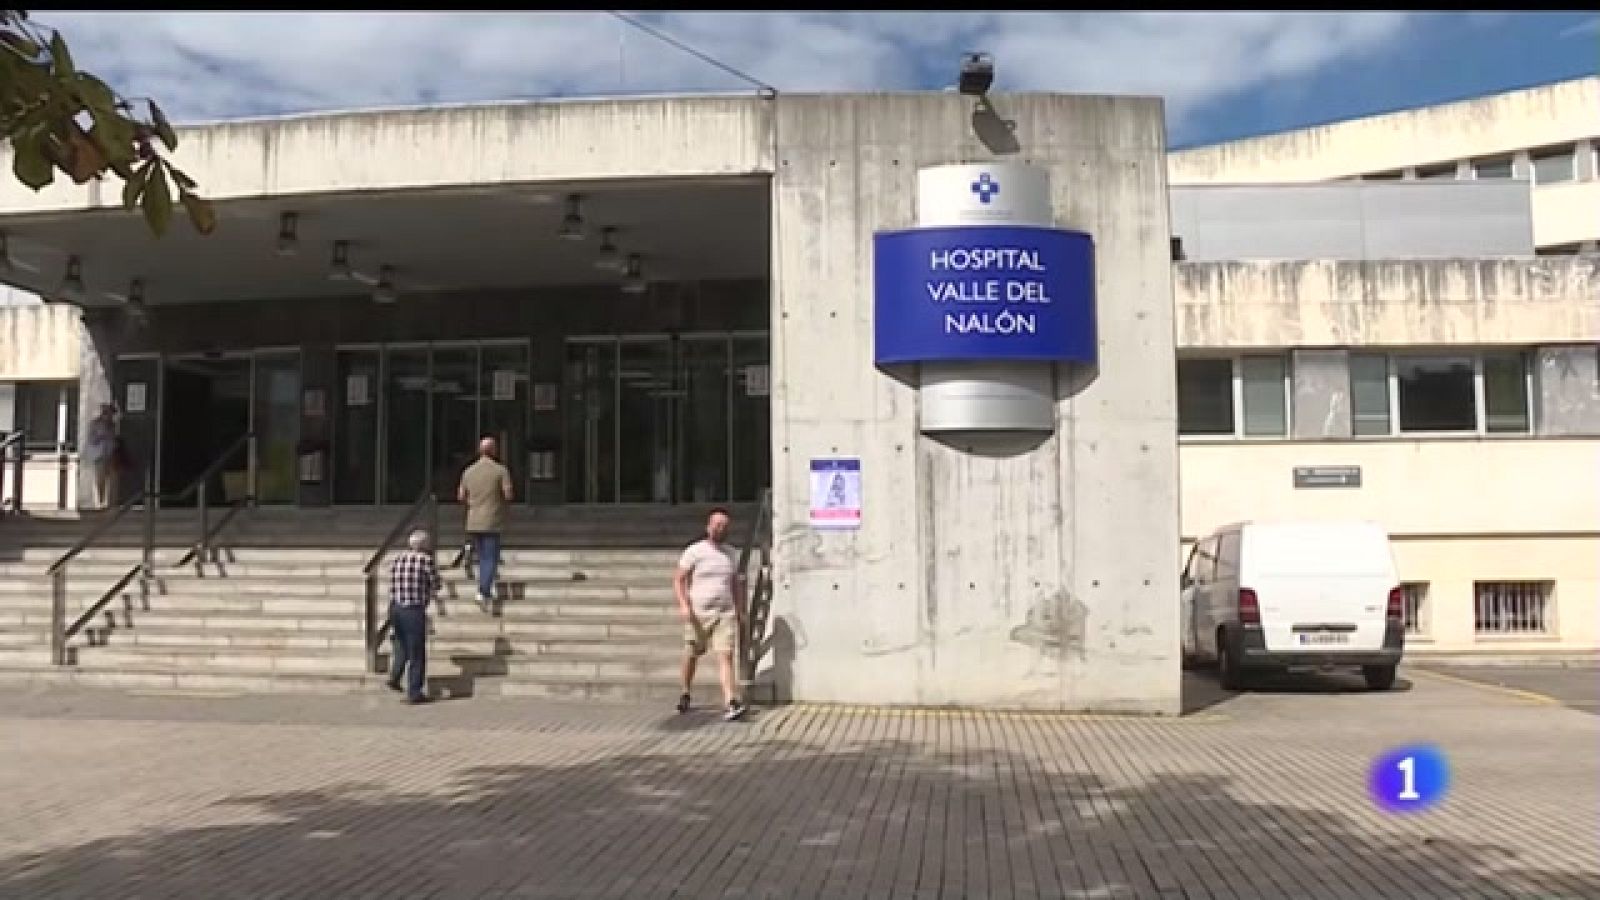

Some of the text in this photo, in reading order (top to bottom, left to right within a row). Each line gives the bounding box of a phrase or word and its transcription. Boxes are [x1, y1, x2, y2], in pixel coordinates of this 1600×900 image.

[930, 249, 1046, 271] HOSPITAL
[926, 281, 1050, 303] VALLE DEL
[944, 309, 1036, 334] NALÓN
